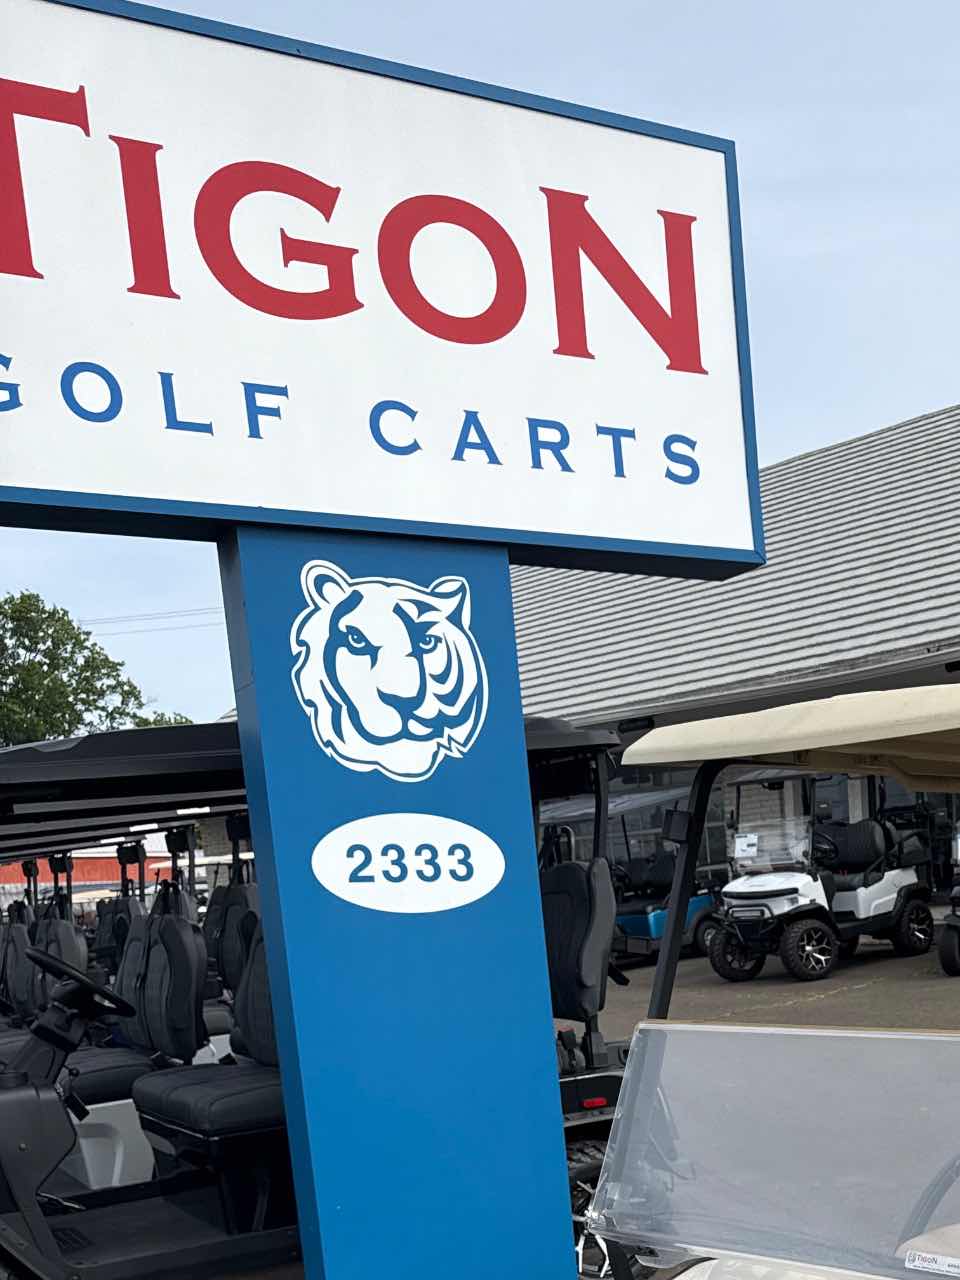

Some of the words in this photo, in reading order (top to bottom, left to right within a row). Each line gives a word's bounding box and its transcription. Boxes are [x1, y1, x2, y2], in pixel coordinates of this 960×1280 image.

[0, 78, 708, 374] TIGON
[370, 401, 701, 486] CARTS
[348, 844, 475, 884] 2333
